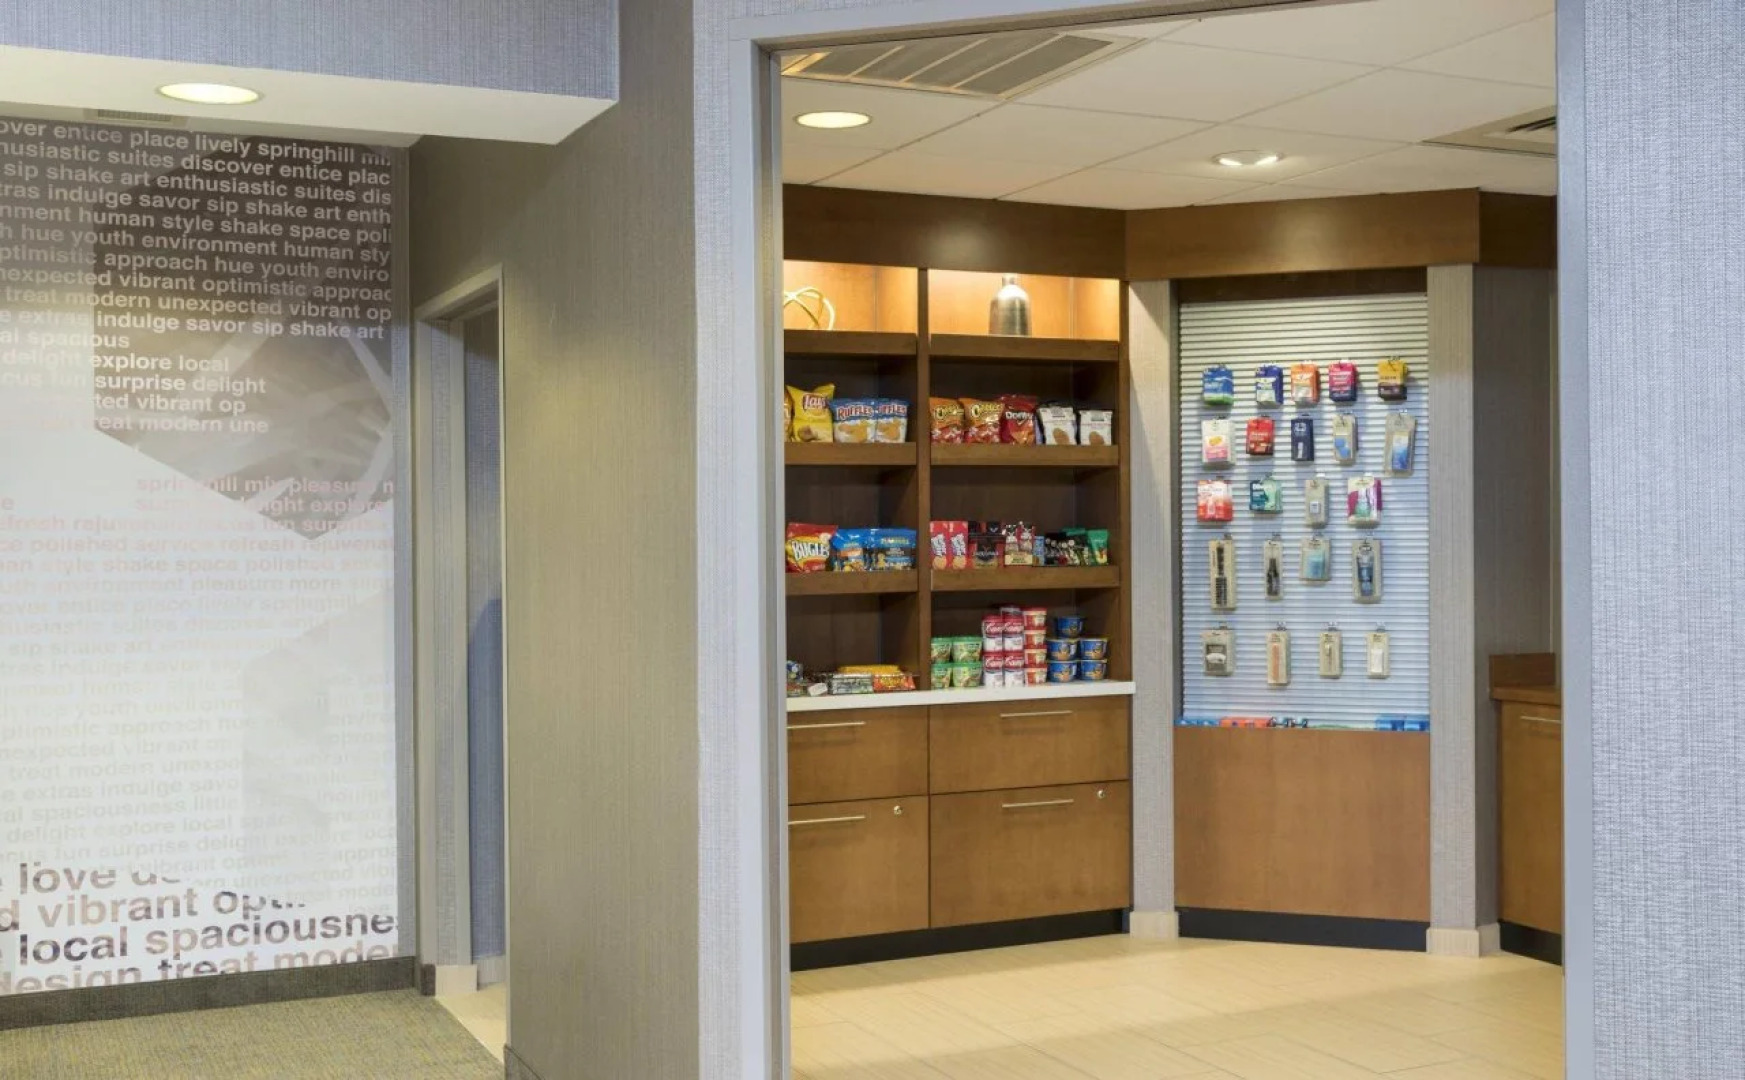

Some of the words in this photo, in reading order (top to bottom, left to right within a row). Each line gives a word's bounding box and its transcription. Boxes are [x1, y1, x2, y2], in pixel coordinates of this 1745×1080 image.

[53, 124, 123, 144] entice
[130, 129, 189, 149] place
[195, 133, 250, 158] lively
[257, 142, 354, 165] springhill
[3, 161, 38, 181] sip
[46, 163, 113, 184] shake
[120, 170, 150, 187] art
[156, 173, 288, 197] enthusiastic
[294, 184, 356, 202] suites
[362, 188, 391, 205] dis
[107, 149, 174, 168] suites
[180, 153, 273, 176] discover
[279, 163, 342, 182] entice
[348, 168, 390, 186] plac
[48, 183, 132, 208] indulge
[139, 193, 200, 210] savor
[207, 197, 239, 217] sip
[245, 199, 307, 218] shake
[314, 206, 340, 221] art
[347, 208, 391, 224] enth
[79, 206, 154, 227] human
[161, 213, 214, 234] style
[220, 218, 283, 236] shake
[289, 224, 350, 242] space
[22, 223, 64, 242] hue
[71, 230, 135, 247] youth
[142, 233, 277, 256] environment
[284, 241, 353, 260] human
[360, 247, 390, 266] sty
[104, 252, 206, 271] approach
[214, 255, 254, 274] hue
[260, 261, 319, 279] youth
[325, 264, 389, 282] enviro
[119, 270, 195, 290] vibrant
[202, 277, 306, 297] optimistic
[312, 285, 391, 302] approac
[5, 286, 57, 304] treat
[64, 291, 150, 308] modern
[158, 296, 281, 316] unexpected
[289, 301, 360, 319] vibrant
[366, 307, 391, 323] op
[18, 309, 90, 325] extras
[97, 311, 180, 333] indulge
[186, 318, 245, 333] savor
[252, 318, 284, 338] sip
[290, 321, 350, 338] shake
[357, 325, 384, 339] art
[27, 330, 130, 349] spacious
[90, 352, 172, 372] explore
[179, 354, 229, 372] local
[95, 373, 186, 393] surprise
[192, 375, 266, 397] delight
[136, 393, 212, 412] vibrant
[219, 399, 246, 416] op
[139, 416, 221, 432] modern
[100, 778, 182, 799] indulge
[31, 798, 187, 826] spaciousness
[20, 862, 116, 894] love
[37, 888, 198, 928] vibrant
[20, 926, 128, 965] local
[146, 912, 397, 960] spaciousne
[273, 941, 398, 970] mode
